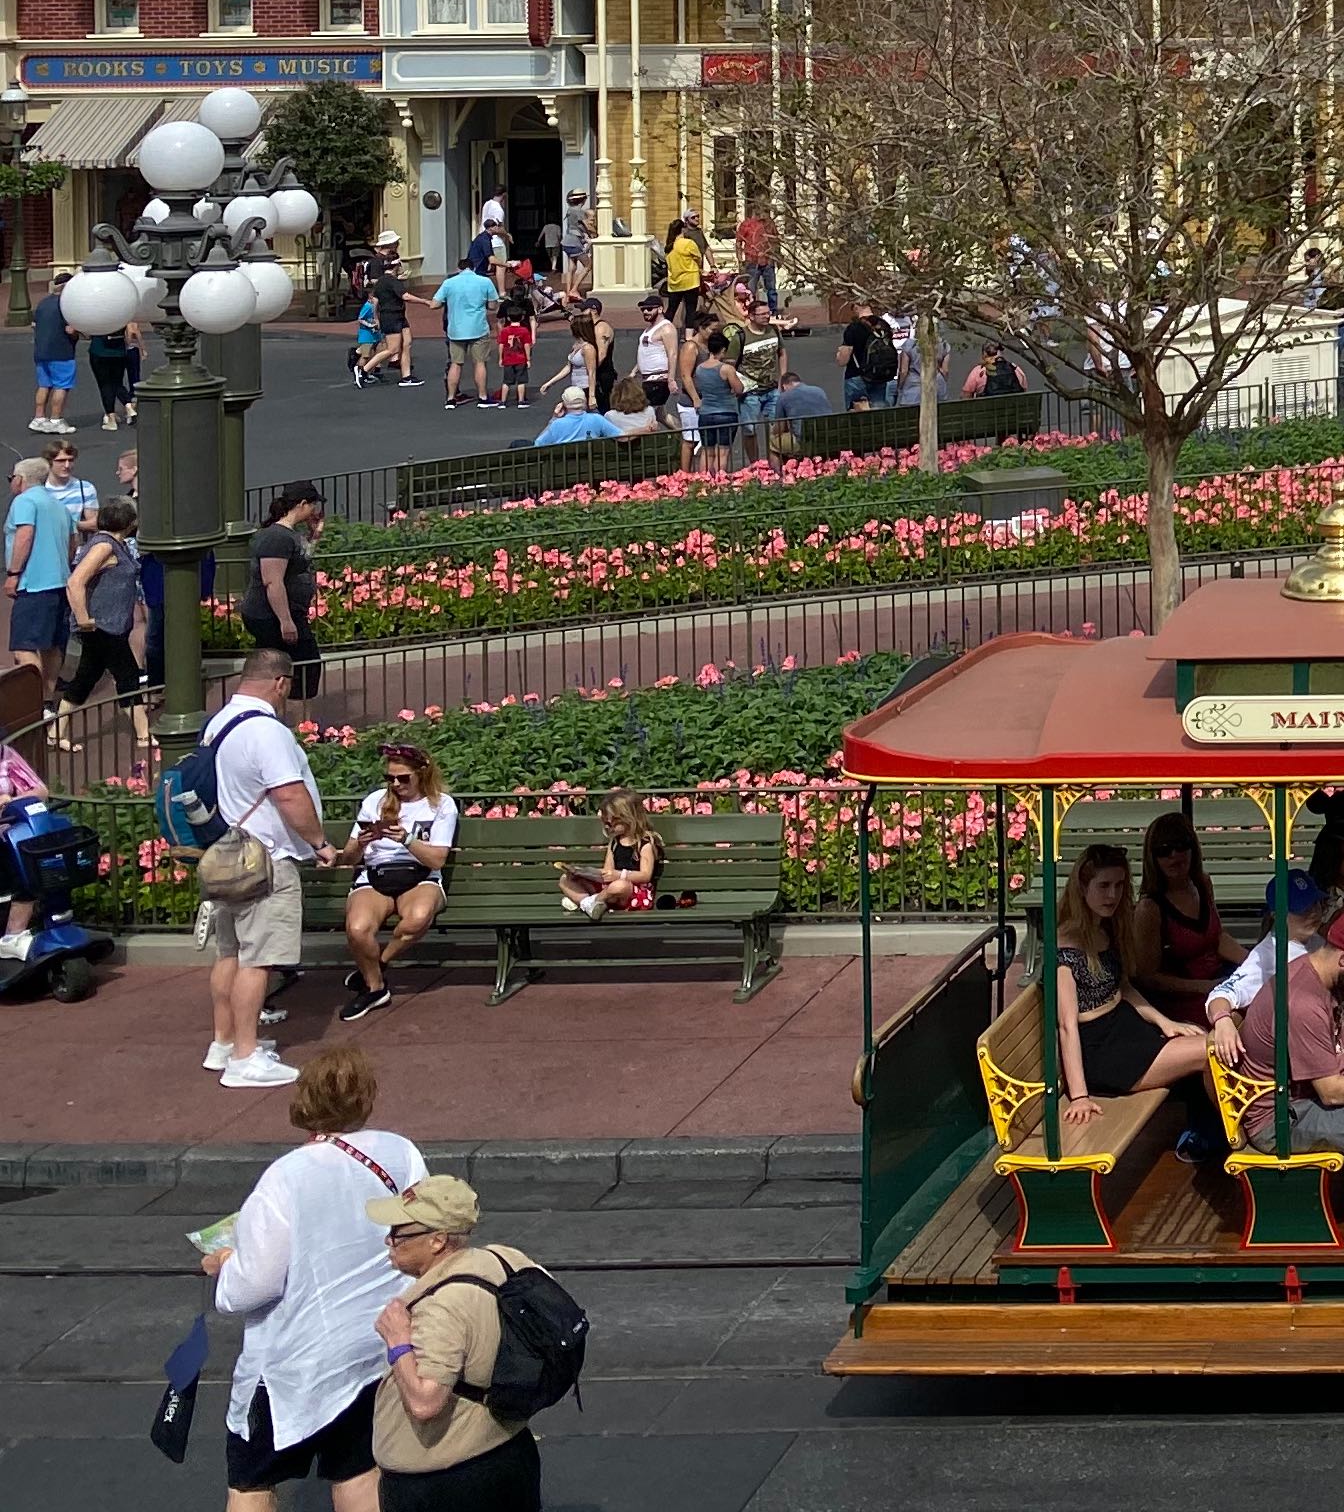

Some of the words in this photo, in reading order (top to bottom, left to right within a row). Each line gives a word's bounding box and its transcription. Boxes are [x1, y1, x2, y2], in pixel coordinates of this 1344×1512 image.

[63, 60, 145, 77] BOOKS
[179, 59, 244, 76] TOYS
[278, 58, 357, 75] MUSIC
